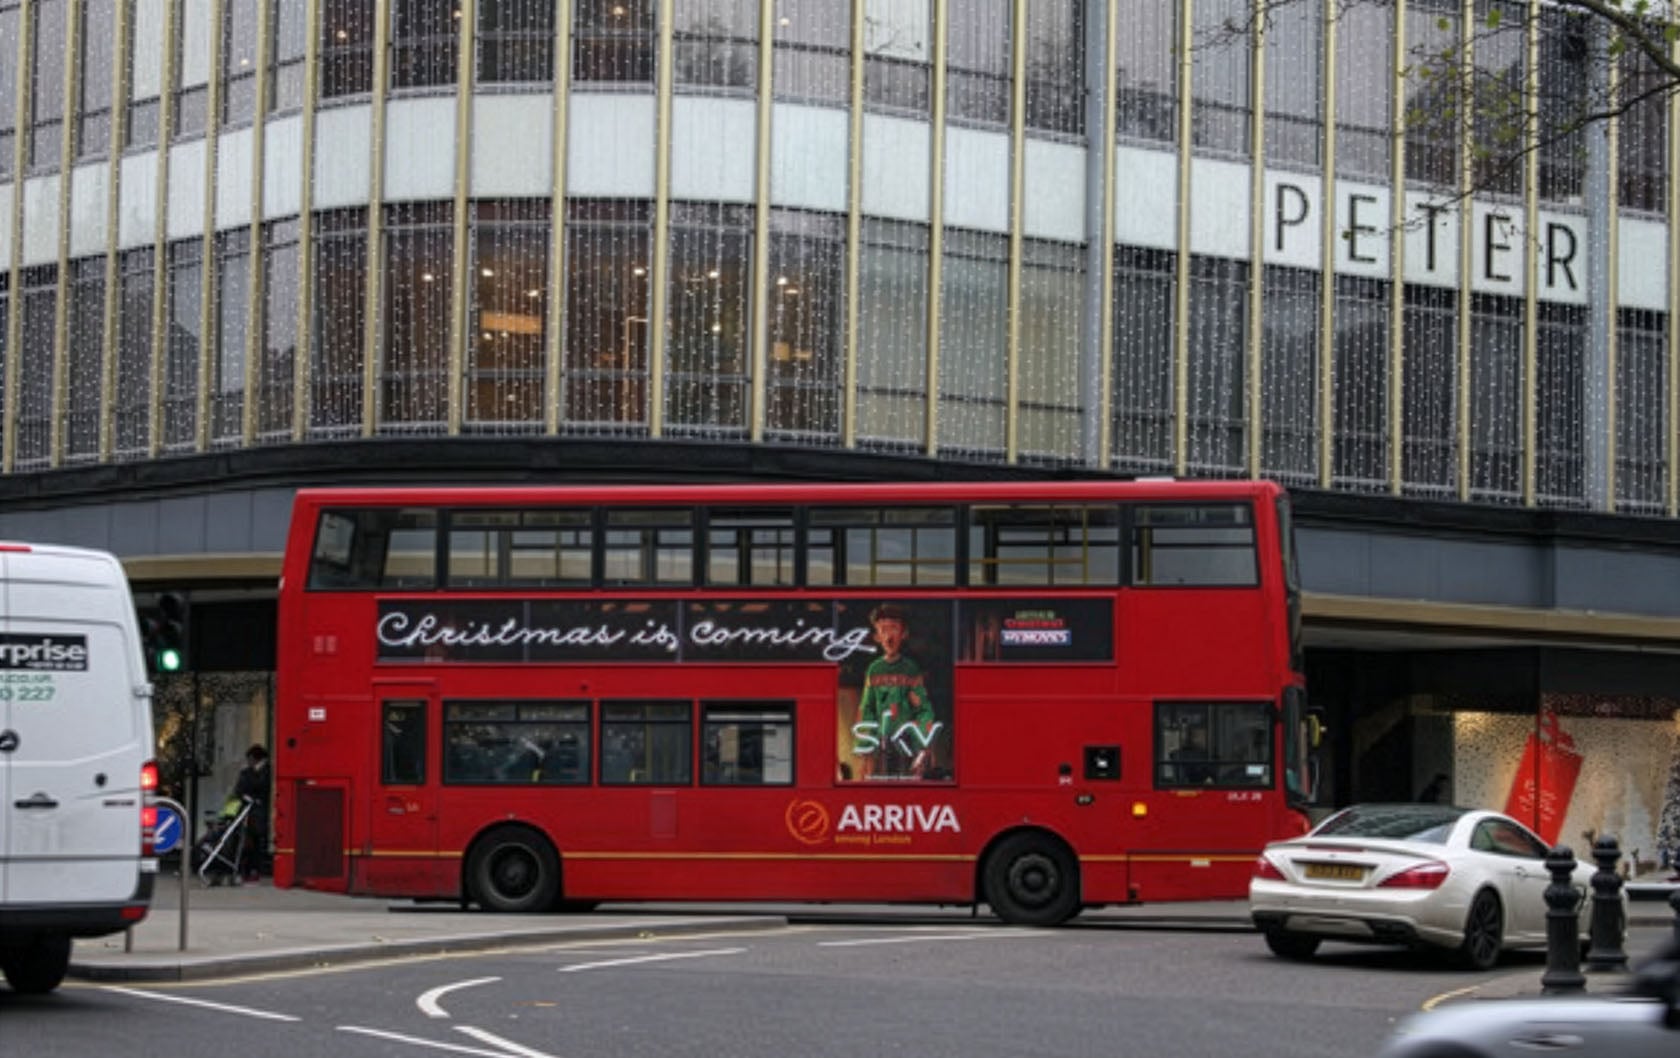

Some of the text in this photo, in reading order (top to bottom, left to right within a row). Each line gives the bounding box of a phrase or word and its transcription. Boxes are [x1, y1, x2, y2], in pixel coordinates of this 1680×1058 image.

[1275, 182, 1579, 291] PETER
[377, 610, 626, 647] Christmas
[17, 686, 56, 701] 227
[836, 804, 962, 832] ARRIVA
